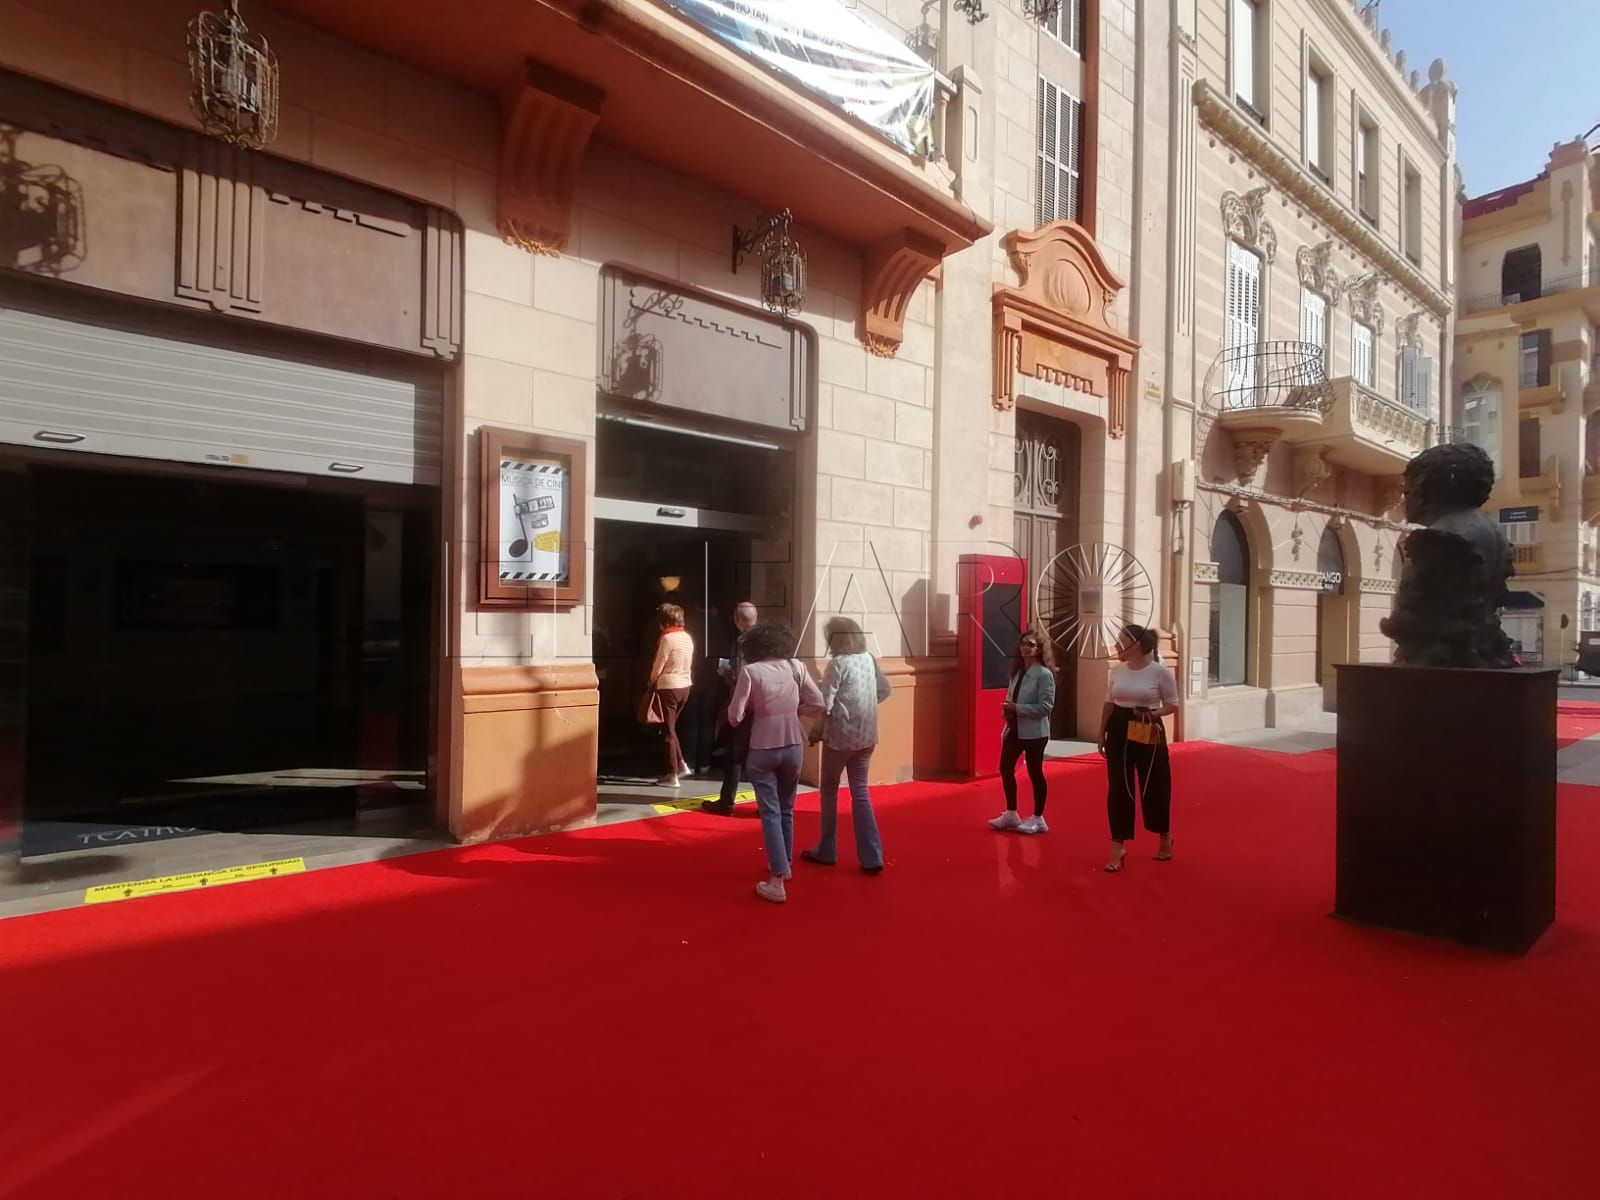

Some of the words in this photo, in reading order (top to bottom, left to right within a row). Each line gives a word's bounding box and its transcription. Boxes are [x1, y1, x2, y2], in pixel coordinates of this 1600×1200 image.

[535, 477, 545, 487] DE
[94, 879, 158, 892] MANTENGA
[246, 858, 301, 870] SEGURIDAD
